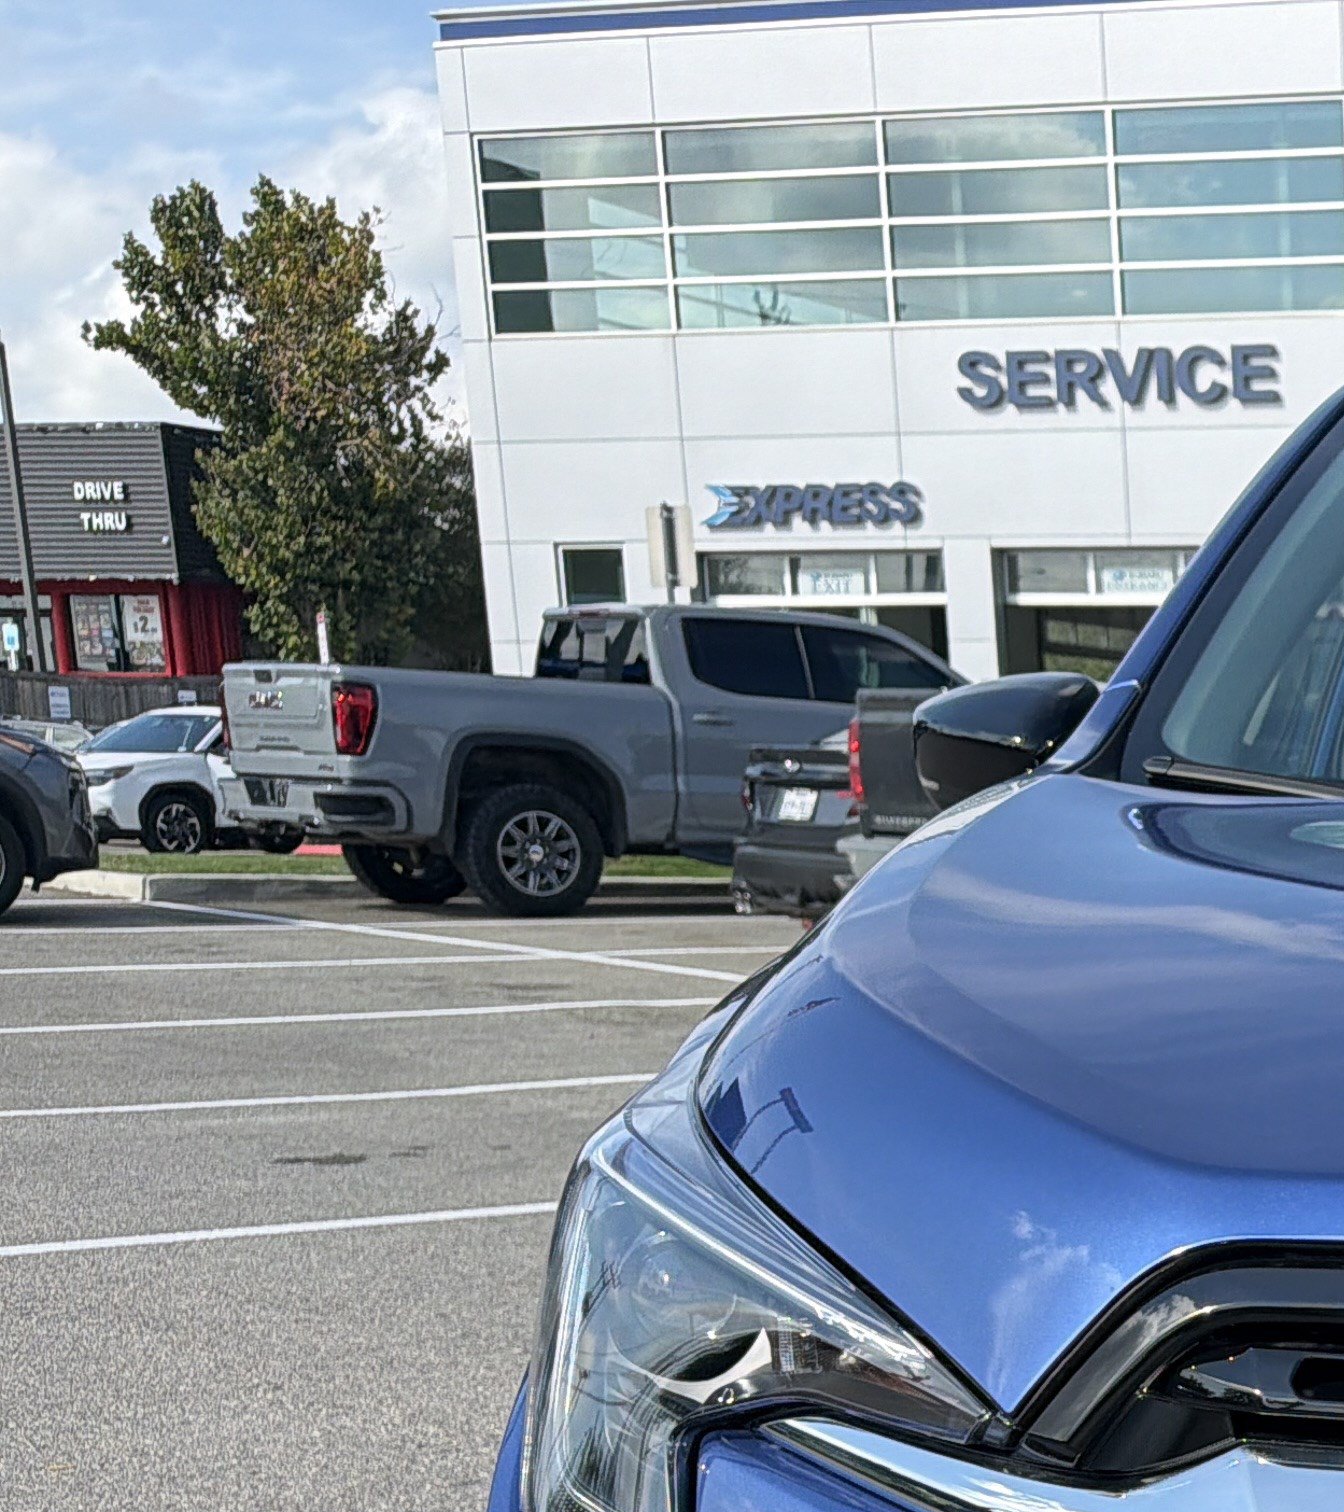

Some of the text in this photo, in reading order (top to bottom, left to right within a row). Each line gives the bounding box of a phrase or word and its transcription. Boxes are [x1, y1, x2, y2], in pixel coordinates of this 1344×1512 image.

[957, 344, 1281, 408] SERVICE
[73, 481, 124, 500] DRIVE
[704, 482, 922, 527] EXPRESS
[80, 511, 127, 531] THRU
